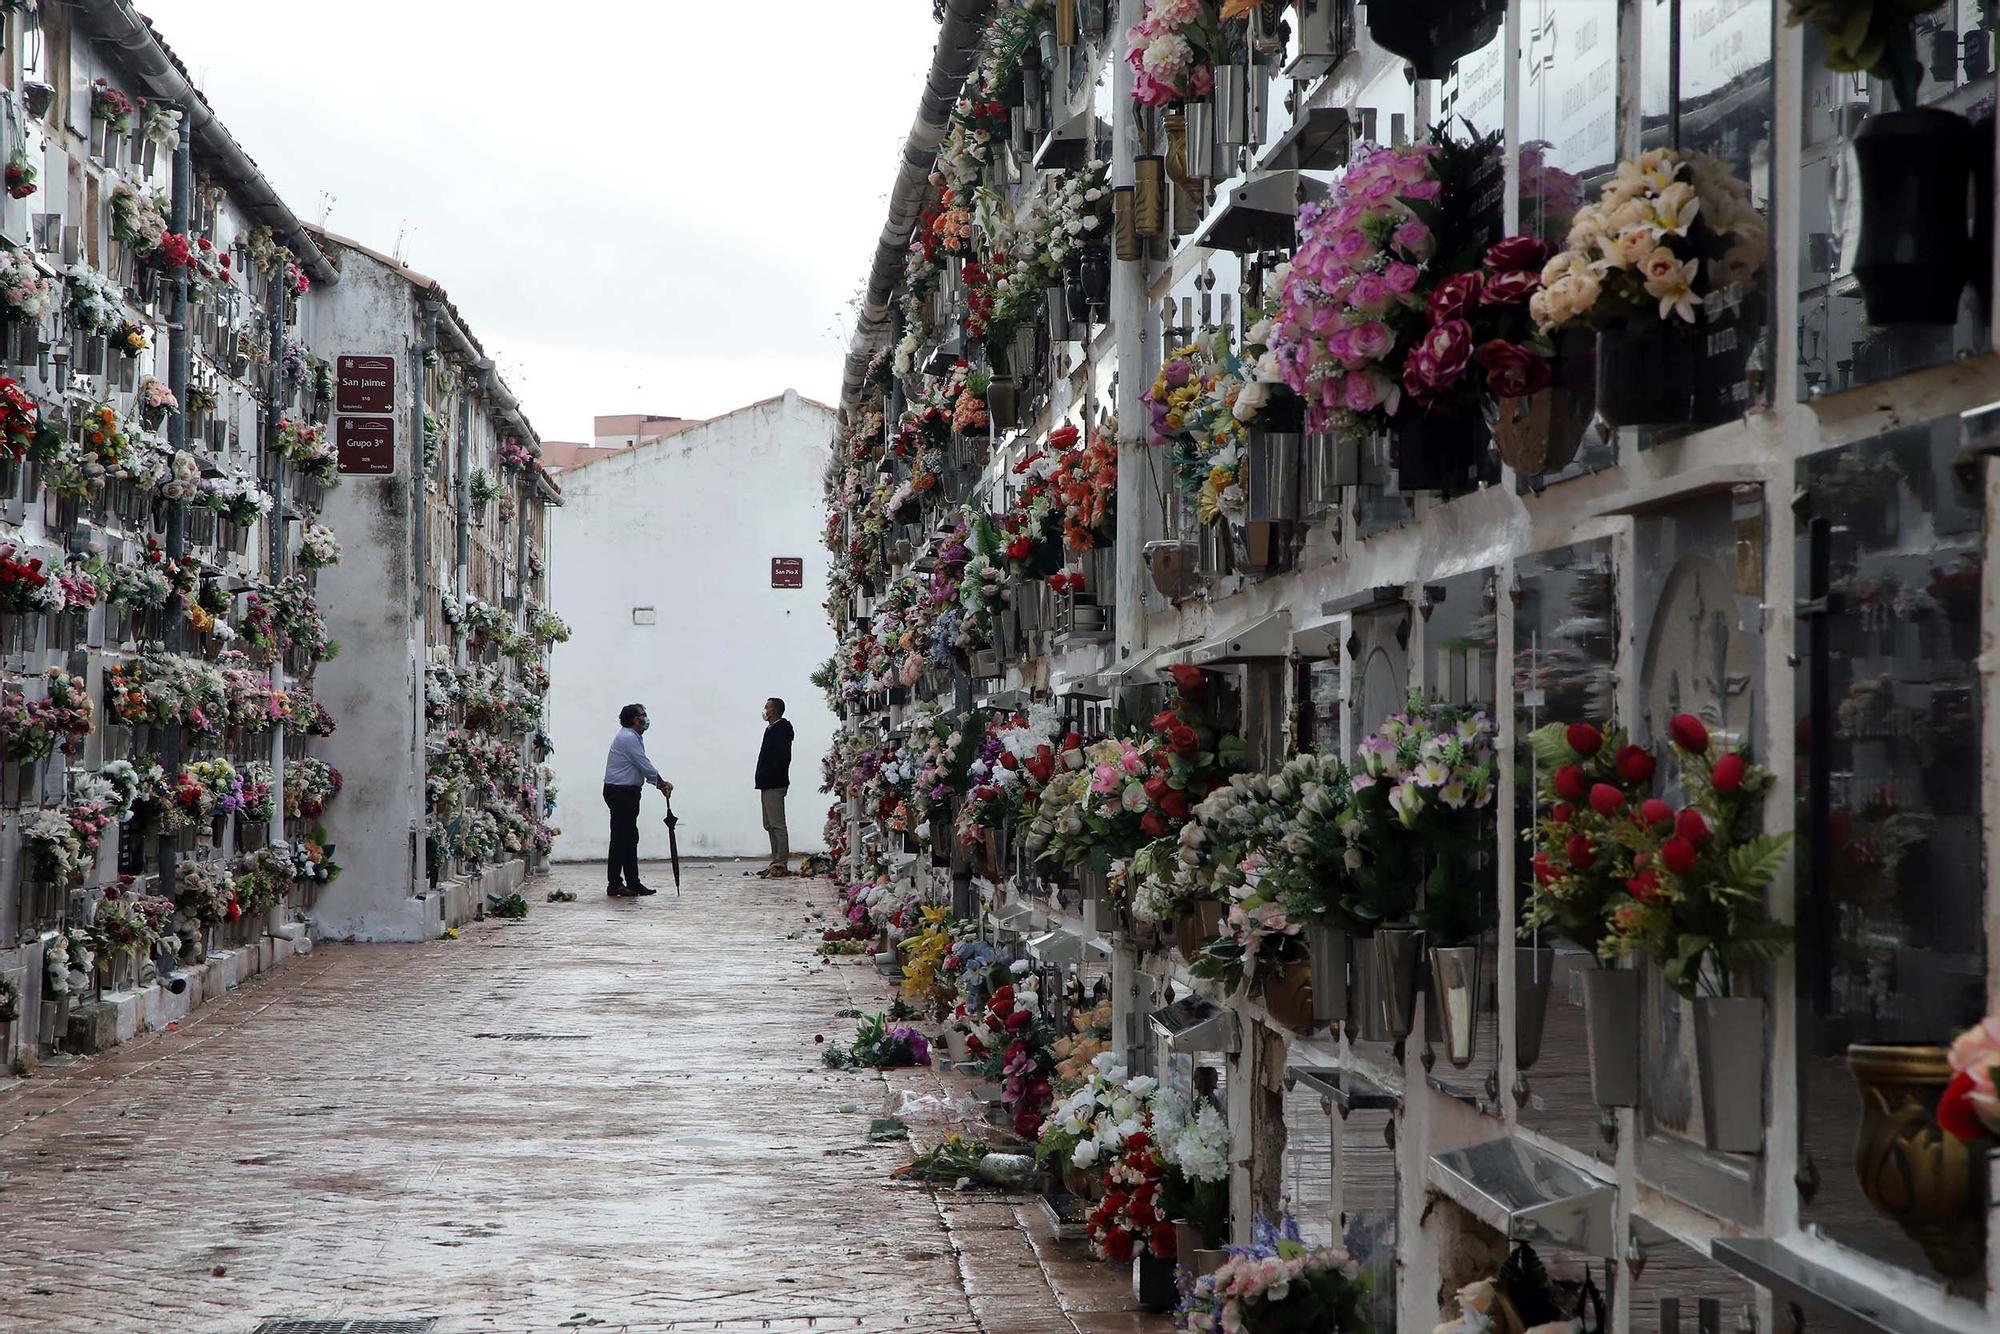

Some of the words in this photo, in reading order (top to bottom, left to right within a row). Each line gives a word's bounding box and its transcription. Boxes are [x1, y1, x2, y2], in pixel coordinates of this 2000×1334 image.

[342, 377, 358, 386] San
[361, 378, 386, 388] Jaime
[346, 438, 372, 448] Grupo
[374, 439, 384, 447] 3º
